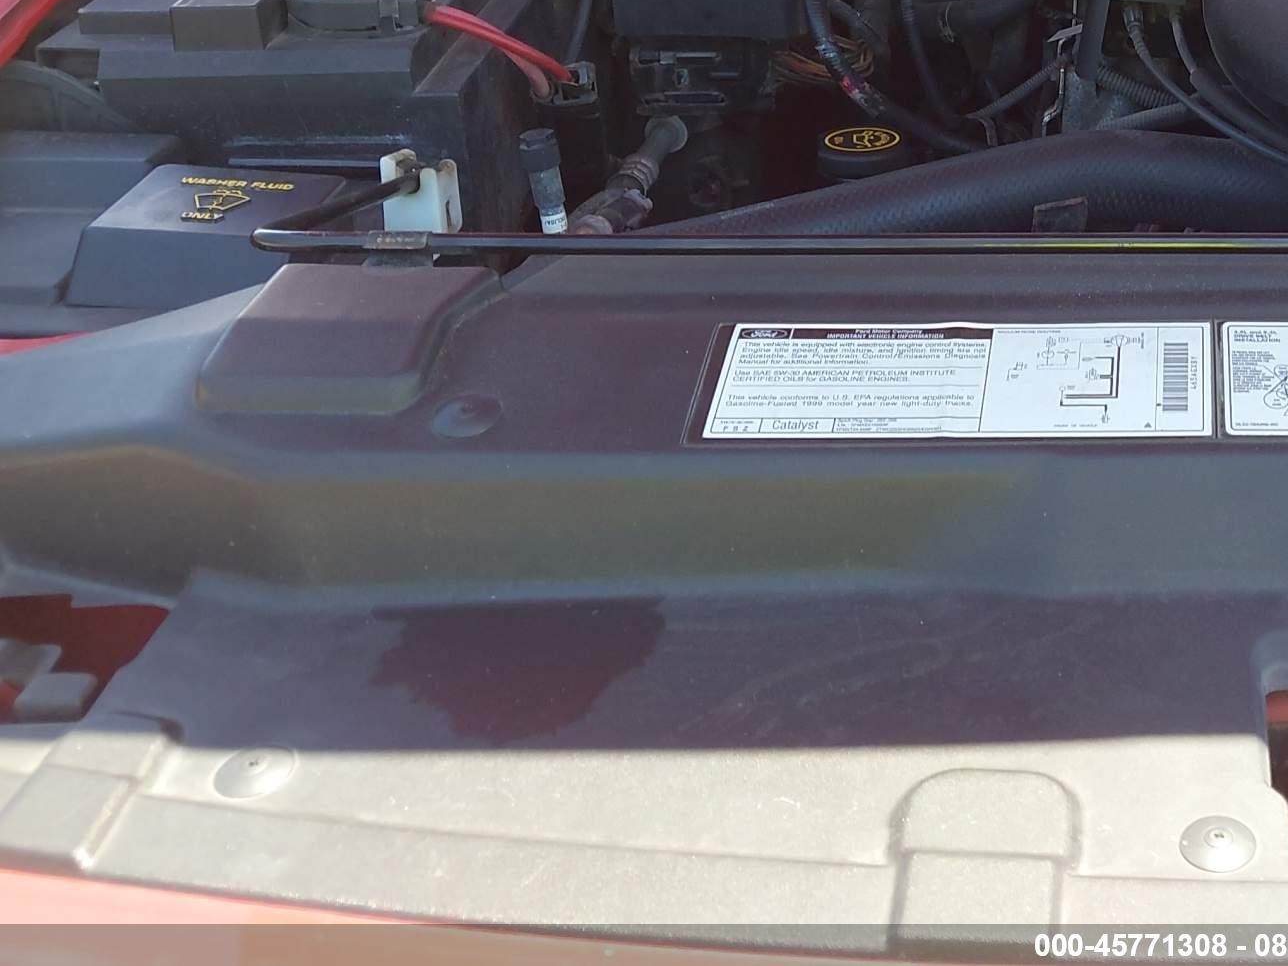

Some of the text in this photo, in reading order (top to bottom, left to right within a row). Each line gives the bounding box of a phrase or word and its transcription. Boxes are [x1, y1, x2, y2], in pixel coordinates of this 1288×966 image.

[181, 177, 295, 190] WASHER FLUID
[181, 211, 223, 219] ONLY
[772, 420, 819, 432] Catalyst
